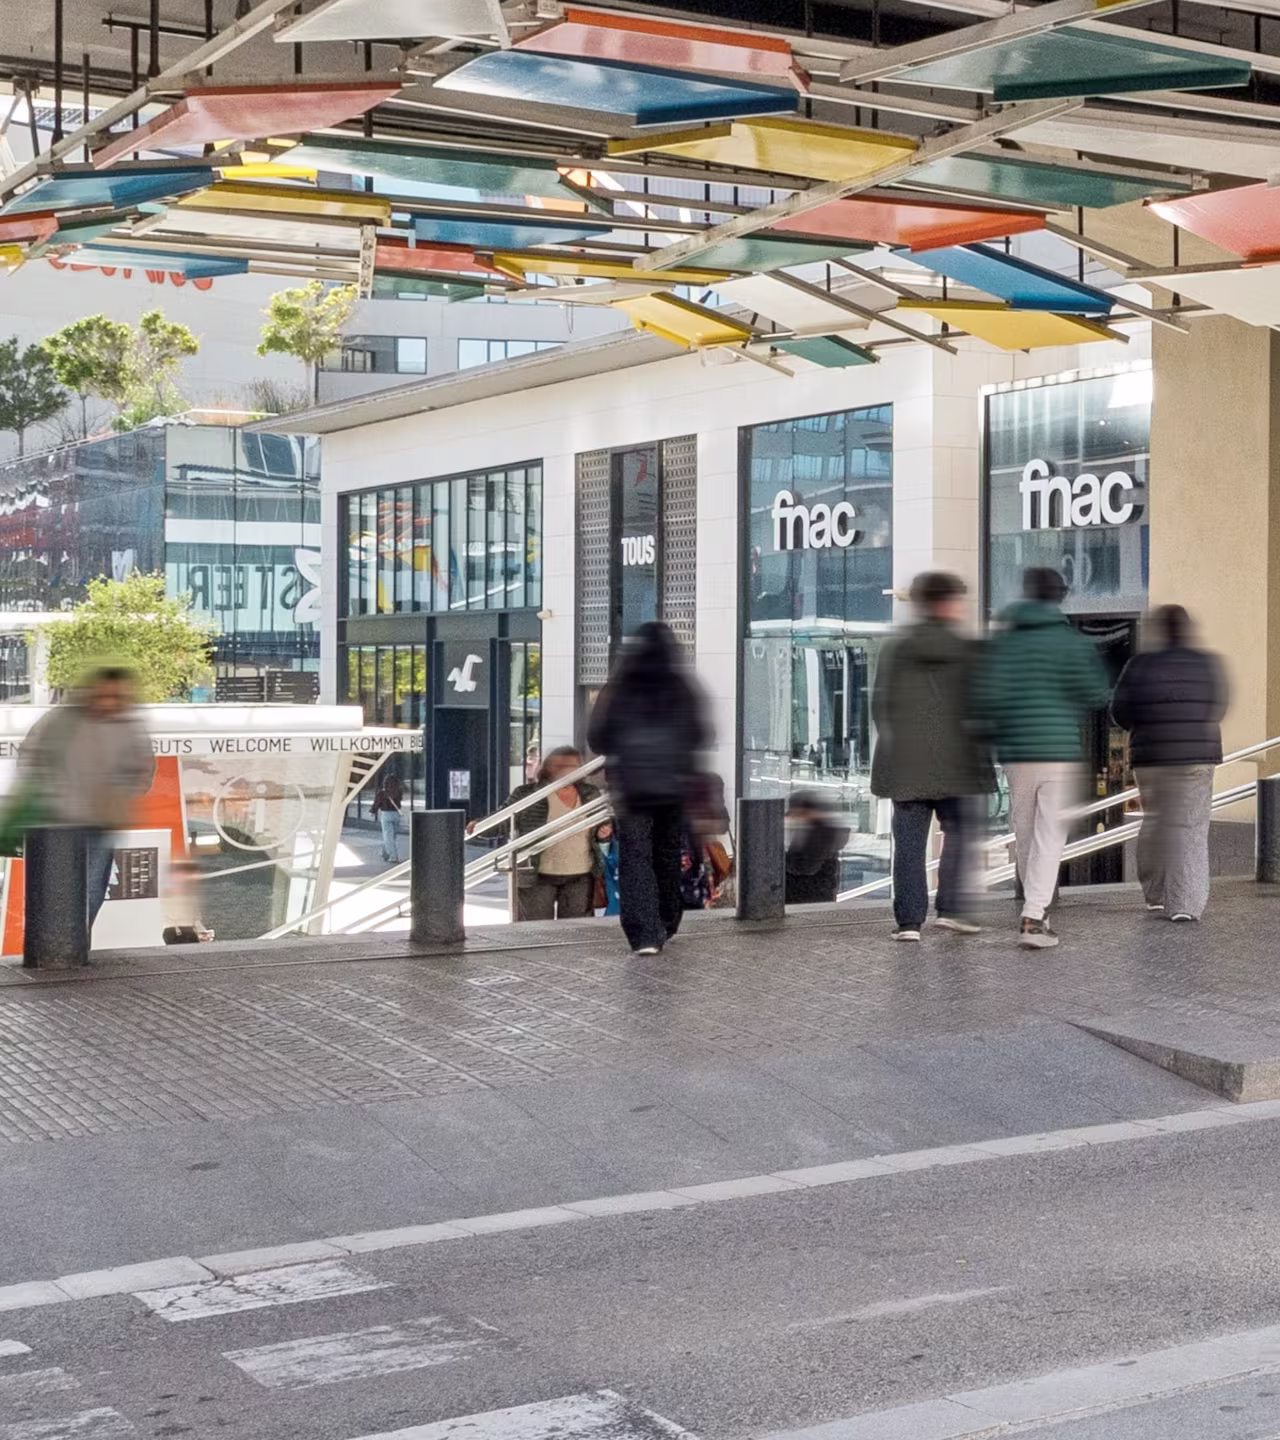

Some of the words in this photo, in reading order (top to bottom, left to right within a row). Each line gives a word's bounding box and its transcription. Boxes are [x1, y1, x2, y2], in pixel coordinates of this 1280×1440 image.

[1019, 458, 1138, 530] fnac
[771, 489, 861, 551] fnac
[621, 534, 655, 566] TOUS
[209, 737, 292, 753] WELCOME
[310, 735, 404, 751] WILLKOMMEN
